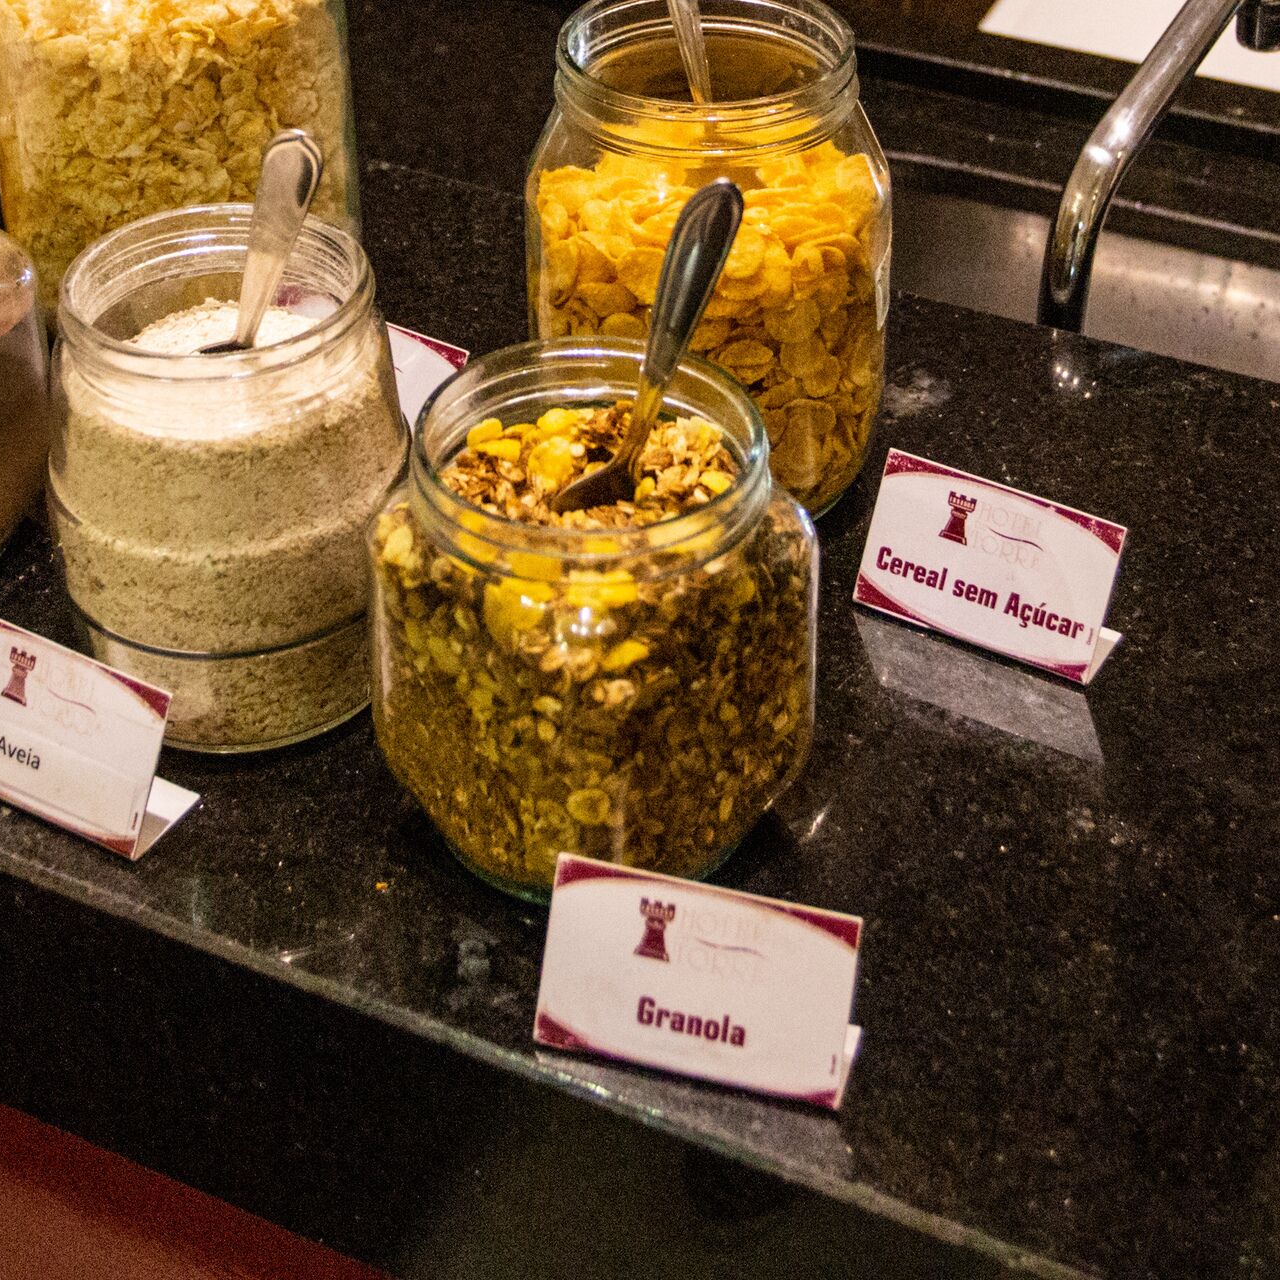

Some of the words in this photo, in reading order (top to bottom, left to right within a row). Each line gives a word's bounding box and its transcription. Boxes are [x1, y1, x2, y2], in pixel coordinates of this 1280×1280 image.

[876, 546, 948, 591] Cereal
[952, 578, 998, 610] sem
[1003, 591, 1085, 639] Açúcar
[636, 996, 746, 1047] Granola
